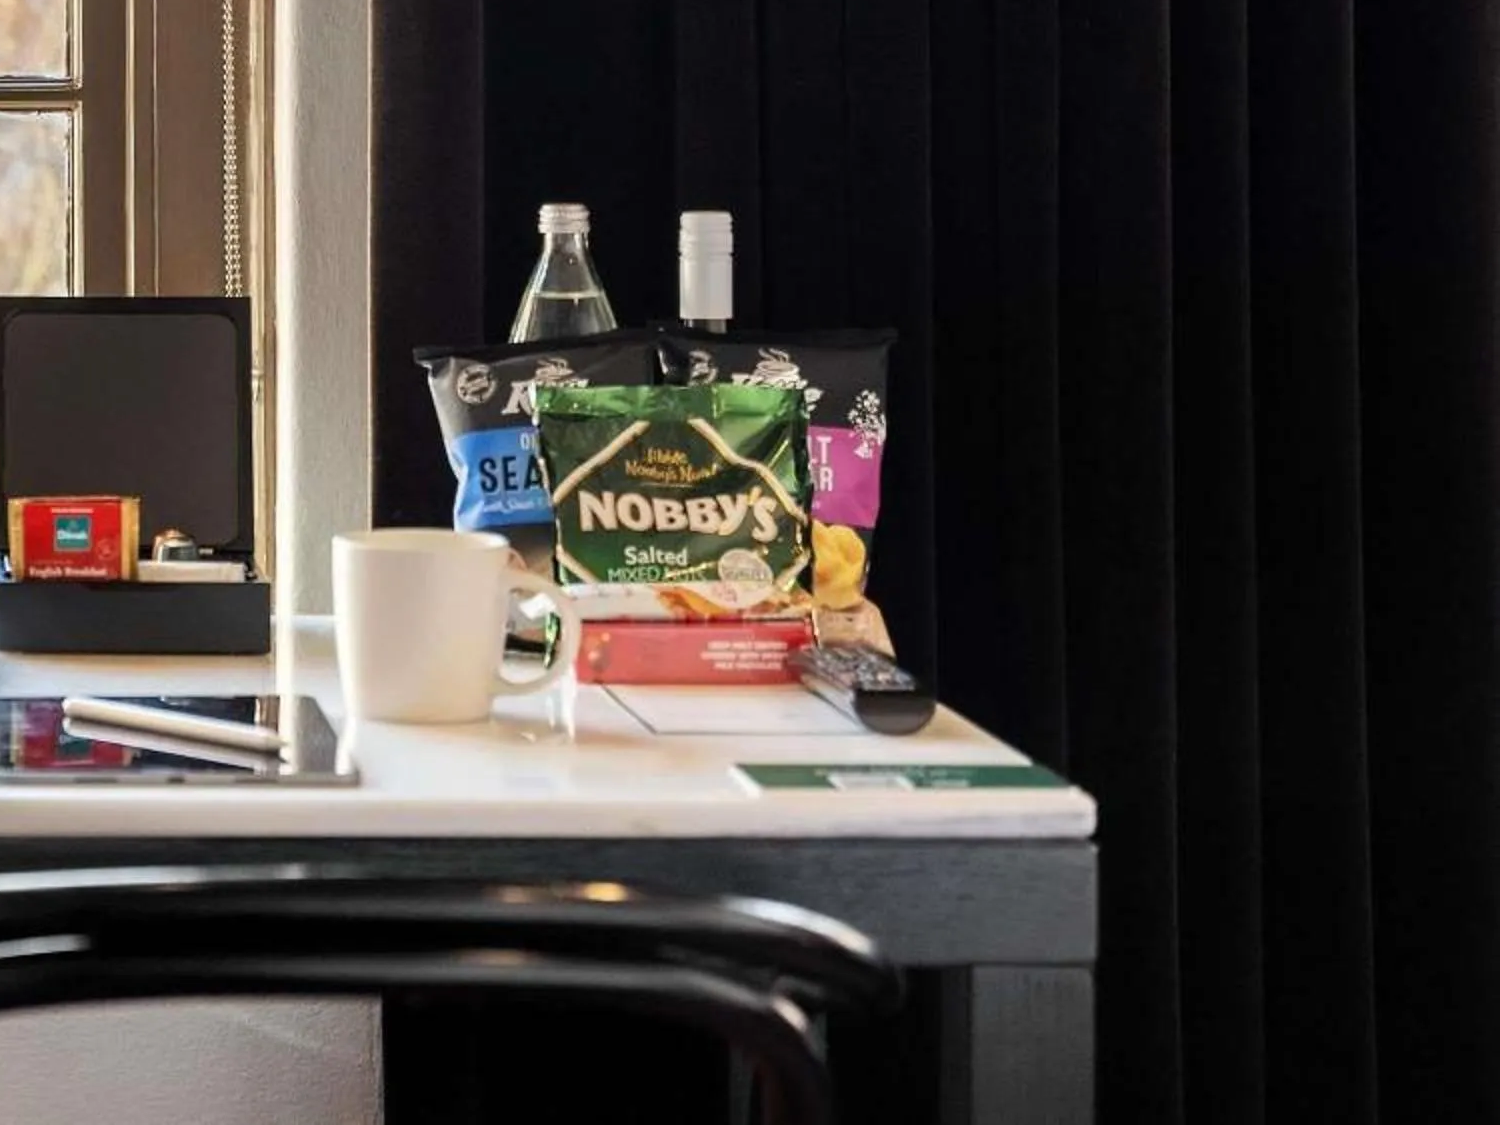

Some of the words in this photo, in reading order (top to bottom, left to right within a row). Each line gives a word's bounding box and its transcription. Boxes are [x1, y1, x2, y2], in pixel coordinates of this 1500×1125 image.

[479, 454, 544, 493] SEA
[624, 545, 688, 567] Salted
[607, 566, 660, 582] MIXED
